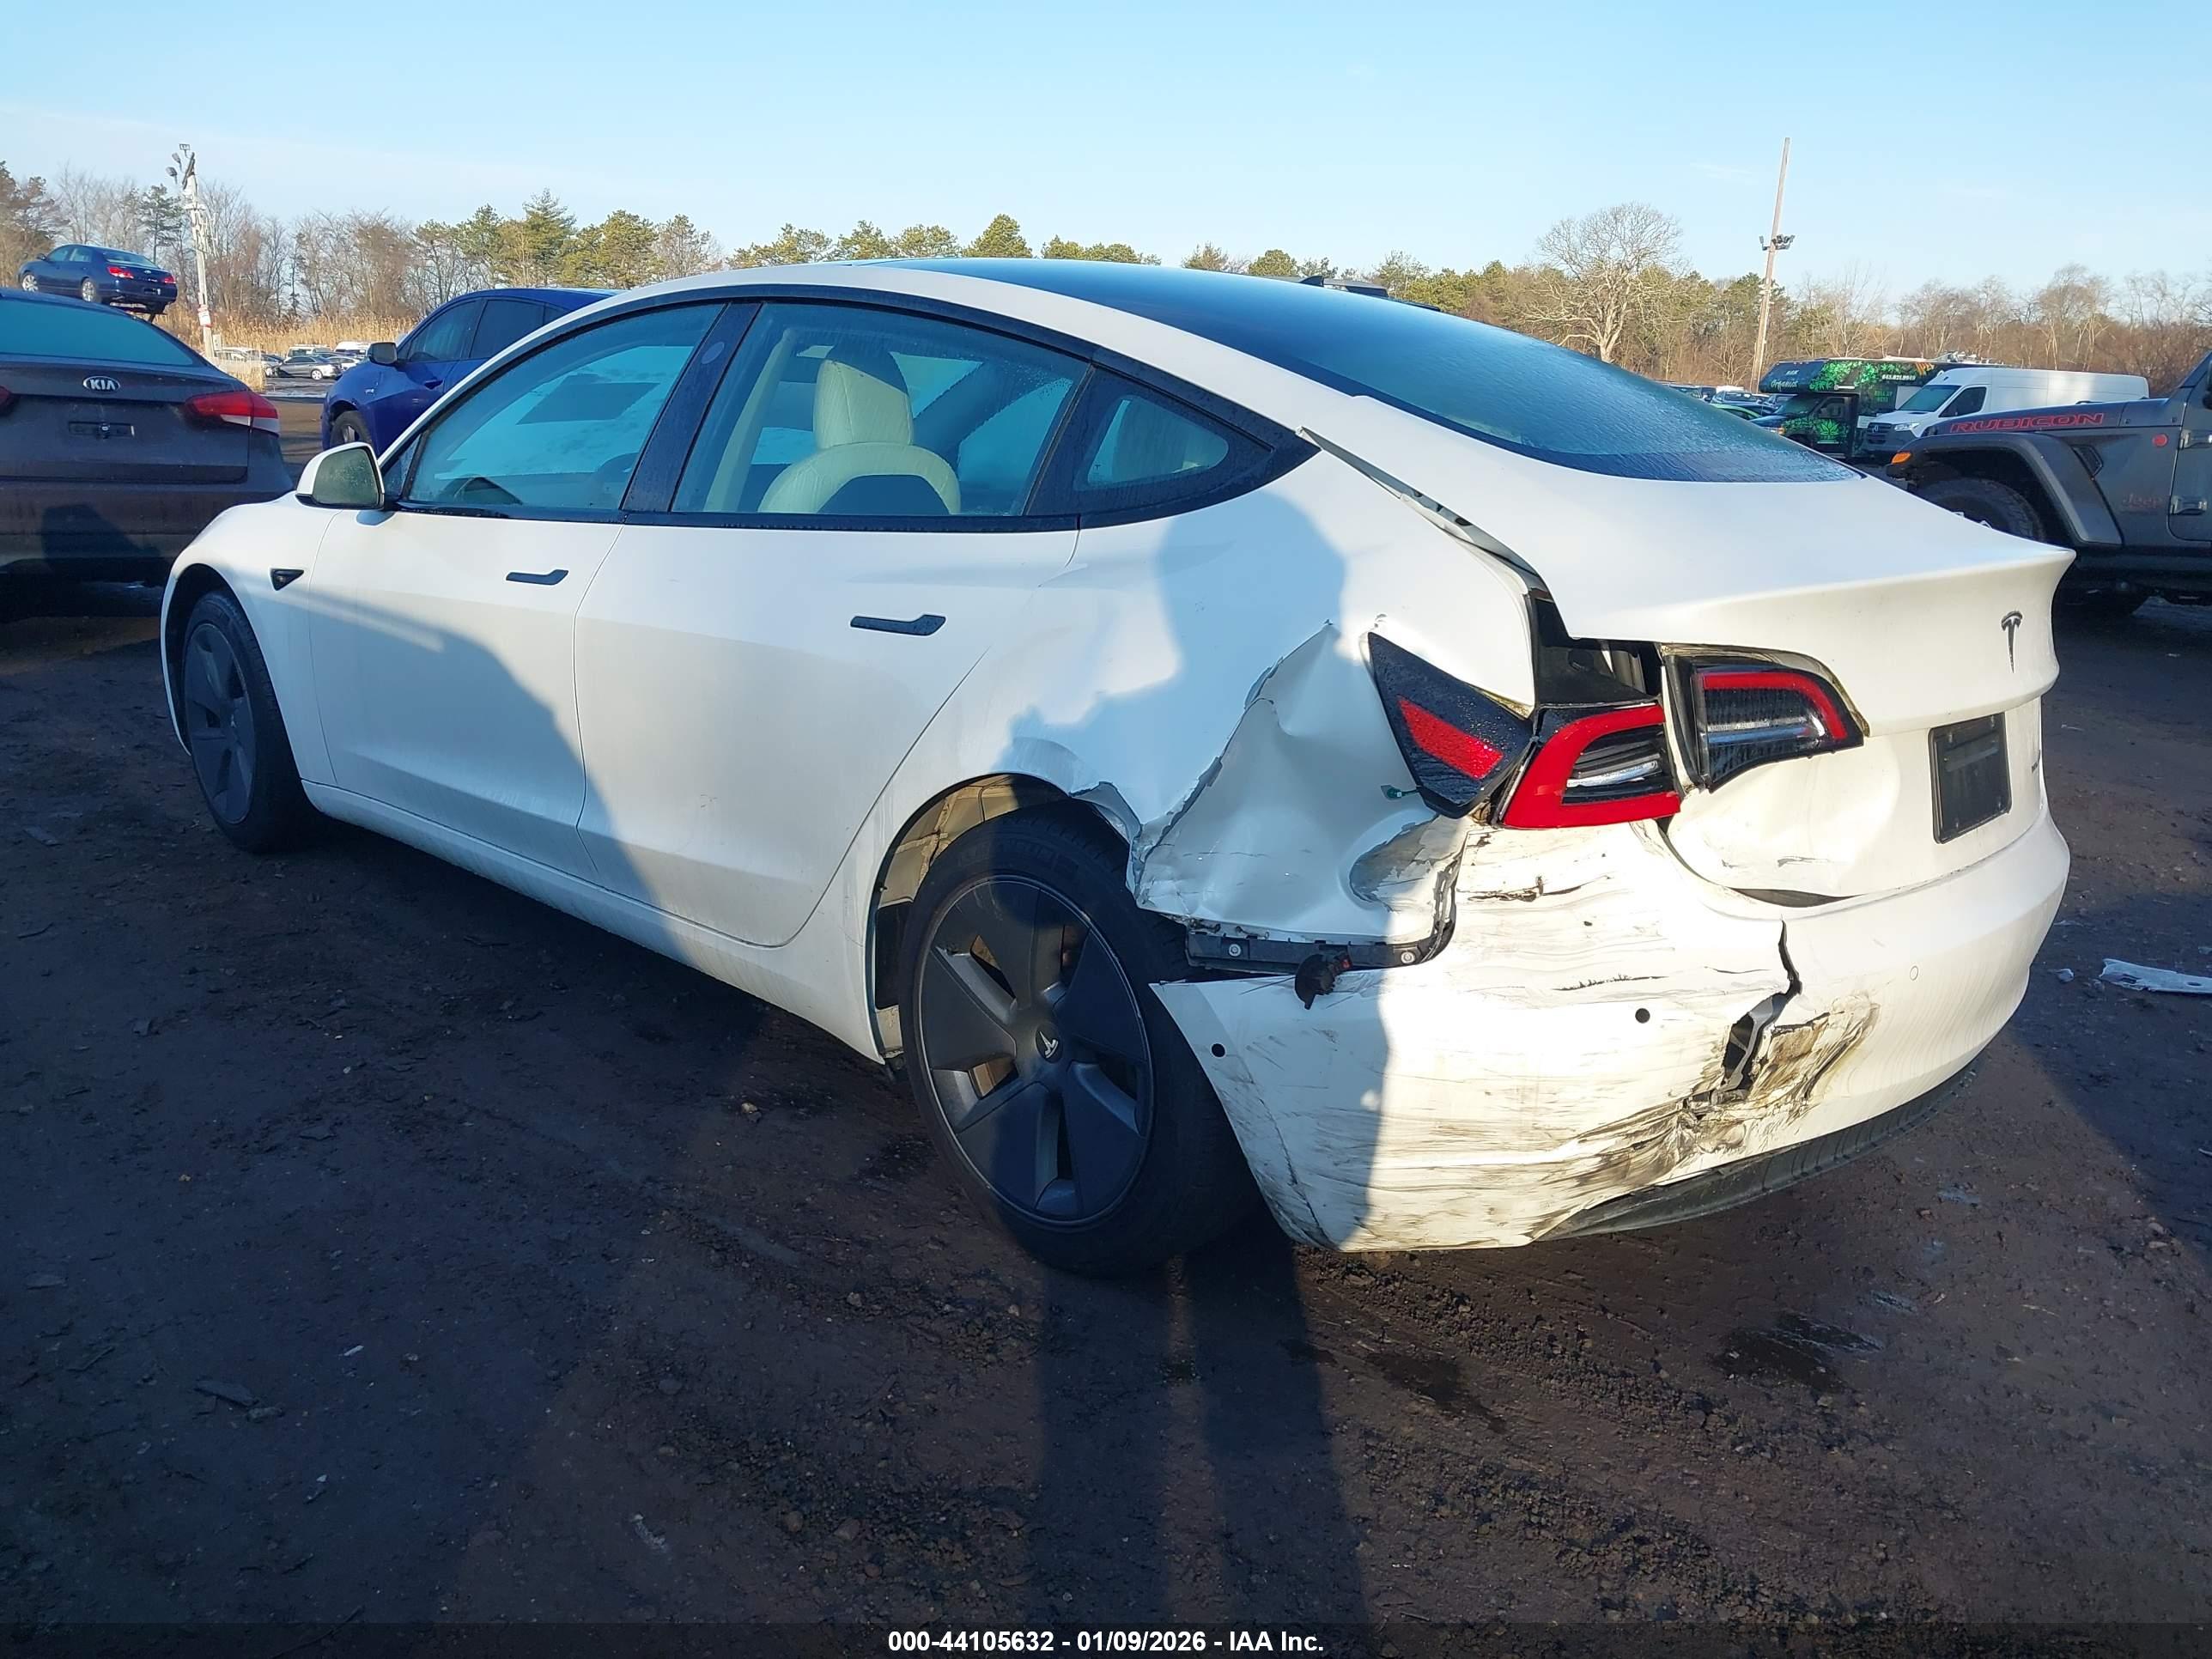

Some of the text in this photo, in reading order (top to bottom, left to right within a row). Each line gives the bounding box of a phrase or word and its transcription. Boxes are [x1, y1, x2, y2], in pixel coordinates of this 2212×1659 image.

[89, 379, 114, 391] KIA
[1951, 413, 2104, 432] RUBICON
[2122, 493, 2160, 508] Jeep
